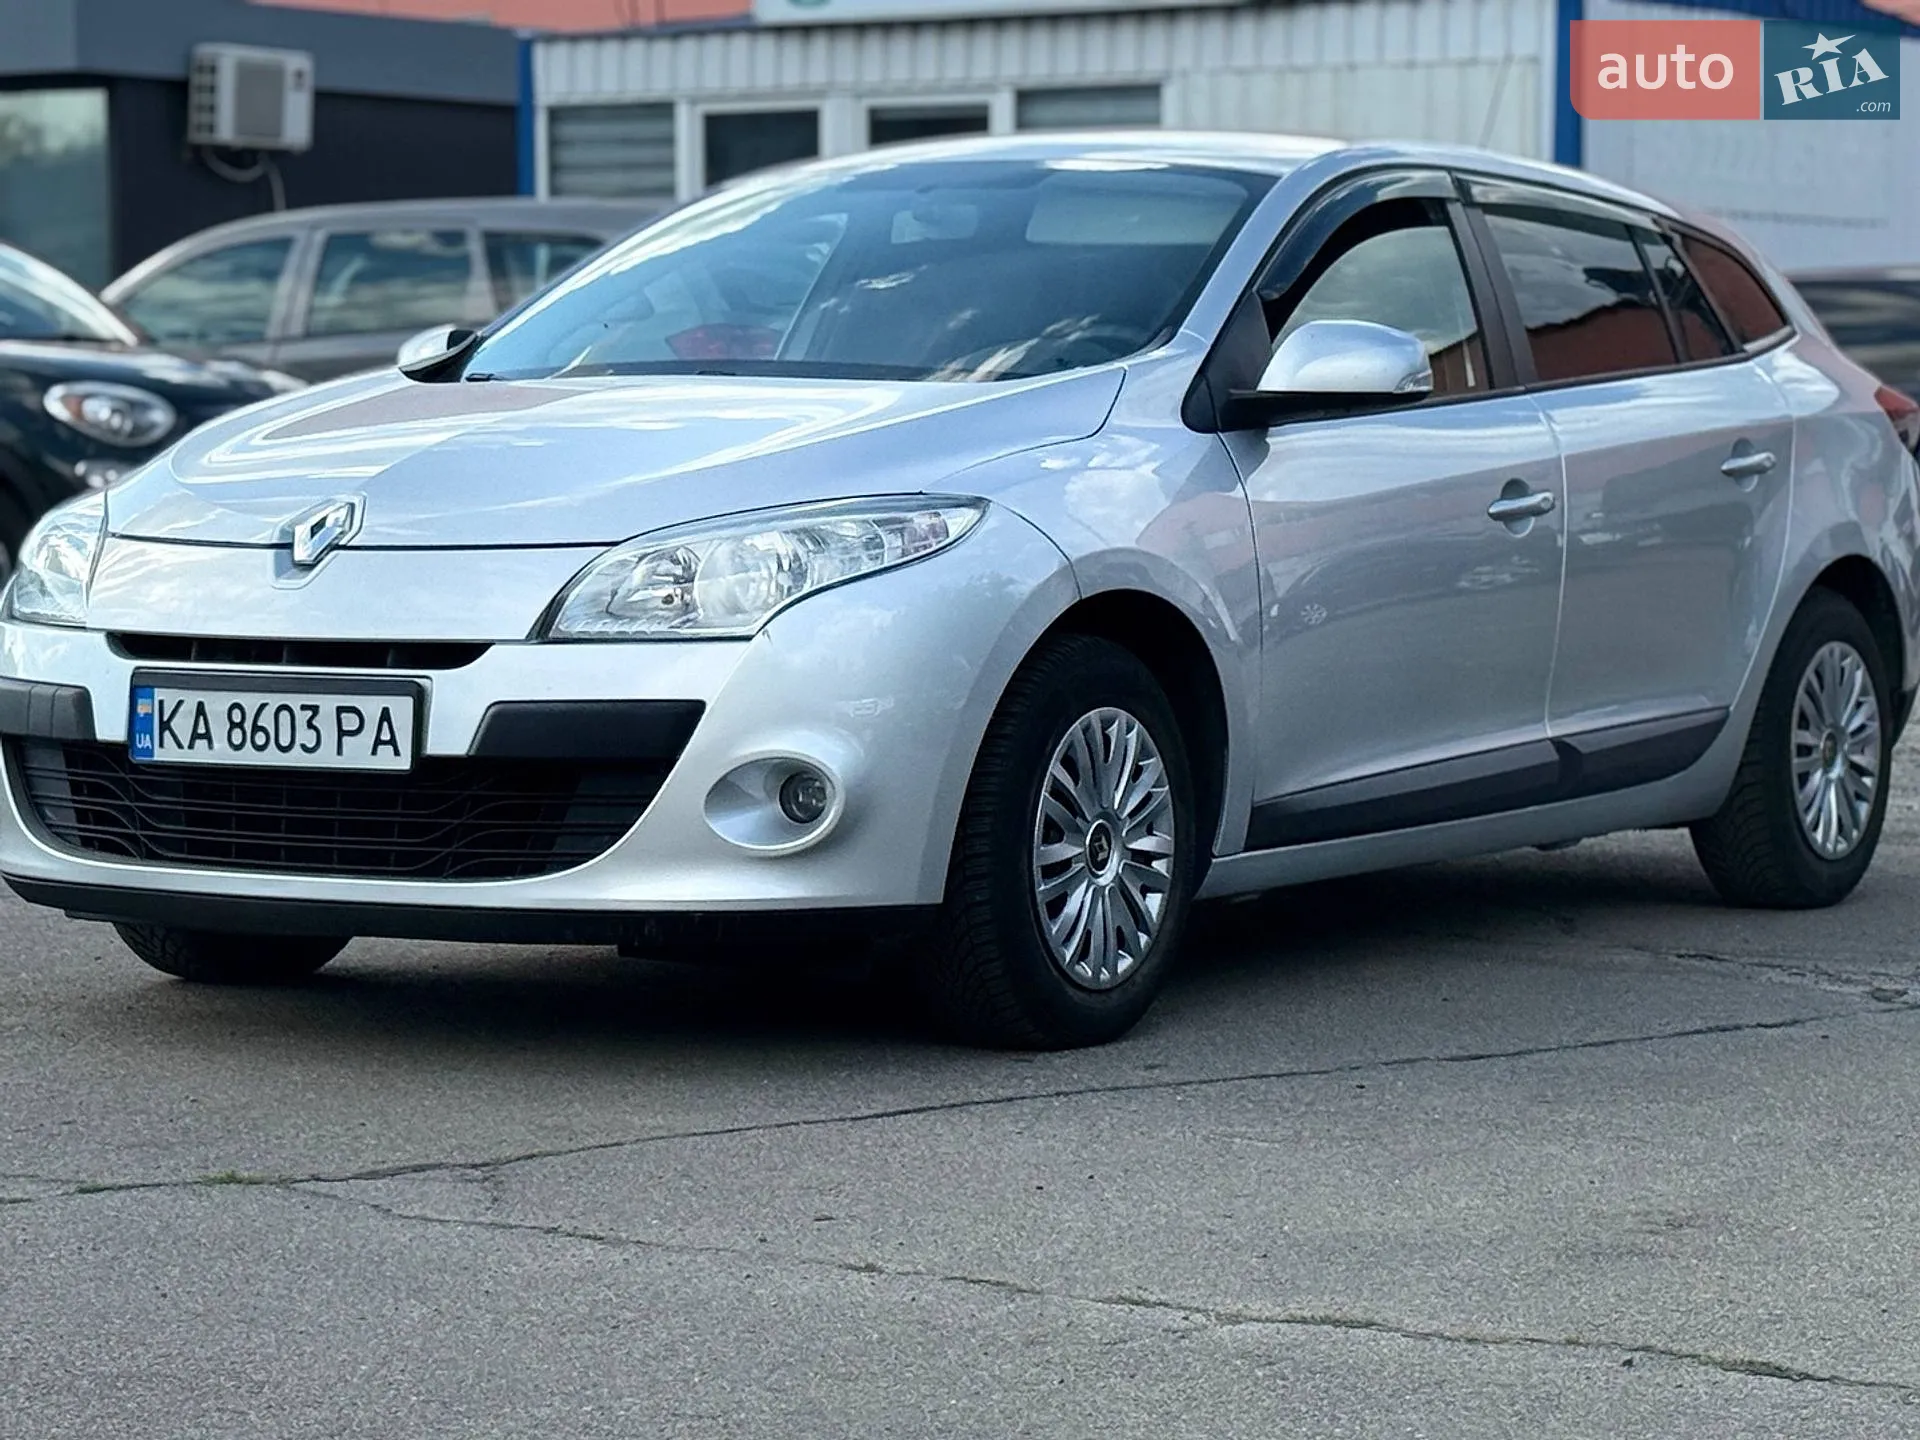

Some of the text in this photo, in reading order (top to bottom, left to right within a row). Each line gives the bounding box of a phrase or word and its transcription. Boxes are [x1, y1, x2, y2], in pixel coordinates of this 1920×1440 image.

[135, 733, 152, 750] UA
[157, 699, 401, 757] KA 8603 PA
